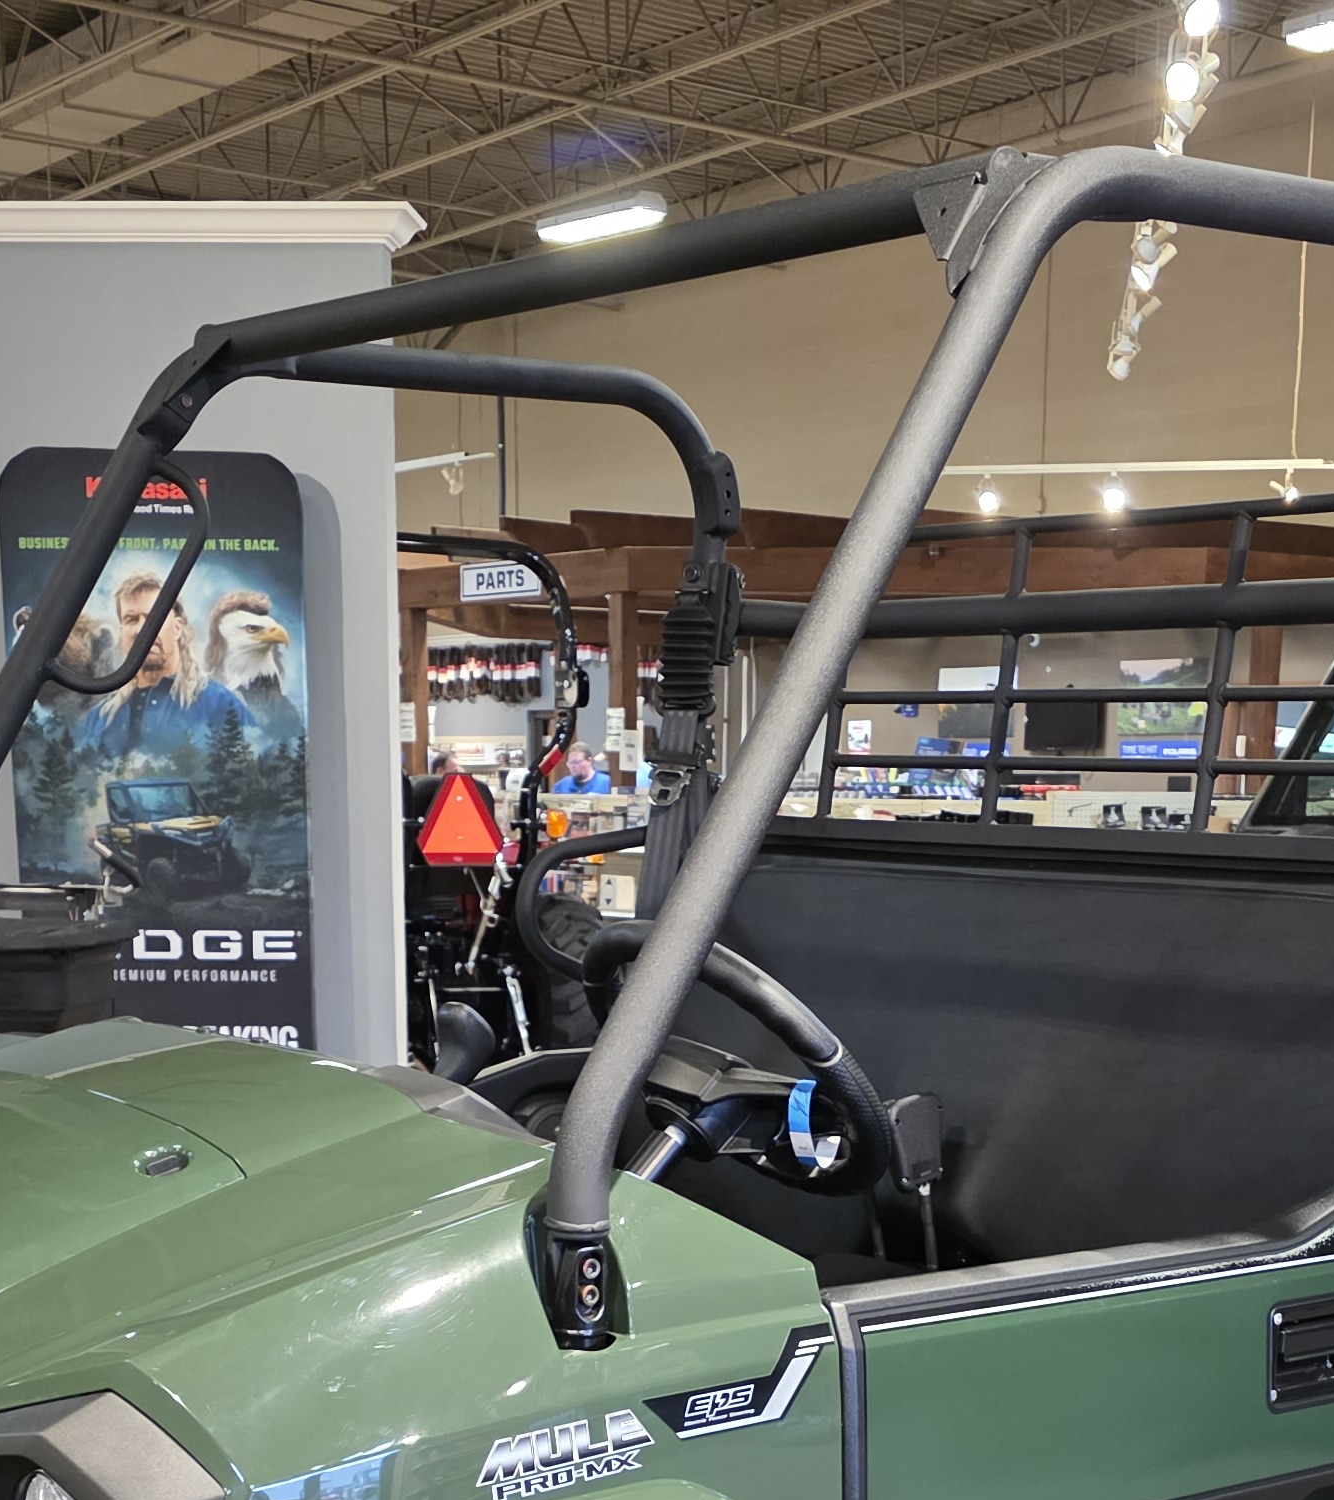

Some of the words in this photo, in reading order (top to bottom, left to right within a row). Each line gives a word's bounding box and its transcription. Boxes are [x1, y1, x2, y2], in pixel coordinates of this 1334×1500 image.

[85, 476, 207, 500] Kasai
[18, 537, 71, 550] BUSINES
[118, 537, 160, 551] FRONT.
[219, 539, 242, 552] THE
[244, 539, 280, 552] BACK.
[475, 569, 525, 590] PARTS
[132, 929, 298, 961] DGE
[113, 969, 167, 982] EMIUM
[173, 969, 278, 983] PERFORMANCE
[475, 1408, 655, 1488] MULE
